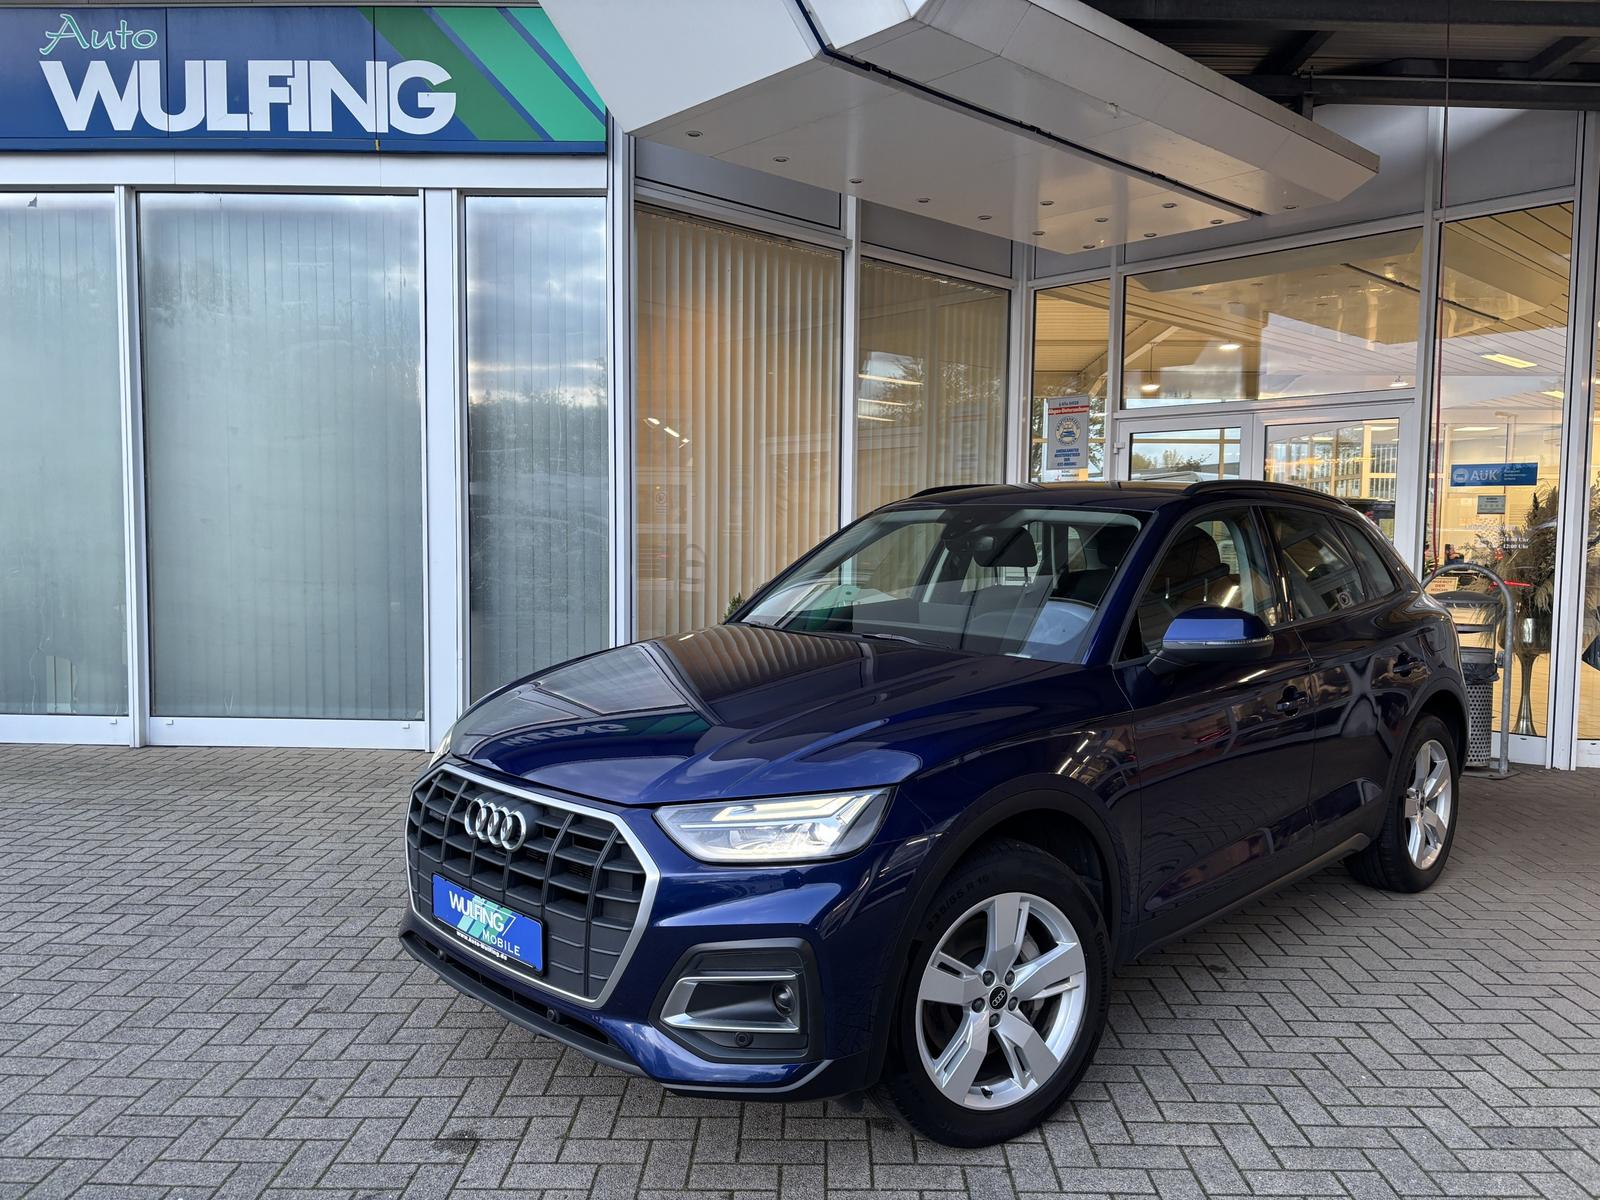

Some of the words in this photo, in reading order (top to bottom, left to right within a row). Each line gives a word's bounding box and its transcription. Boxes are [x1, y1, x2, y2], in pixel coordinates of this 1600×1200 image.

[39, 13, 158, 55] Auto
[39, 60, 456, 135] WULFING
[1470, 469, 1498, 481] AÜK
[448, 890, 505, 932] WULFING
[482, 928, 521, 957] MOBILE
